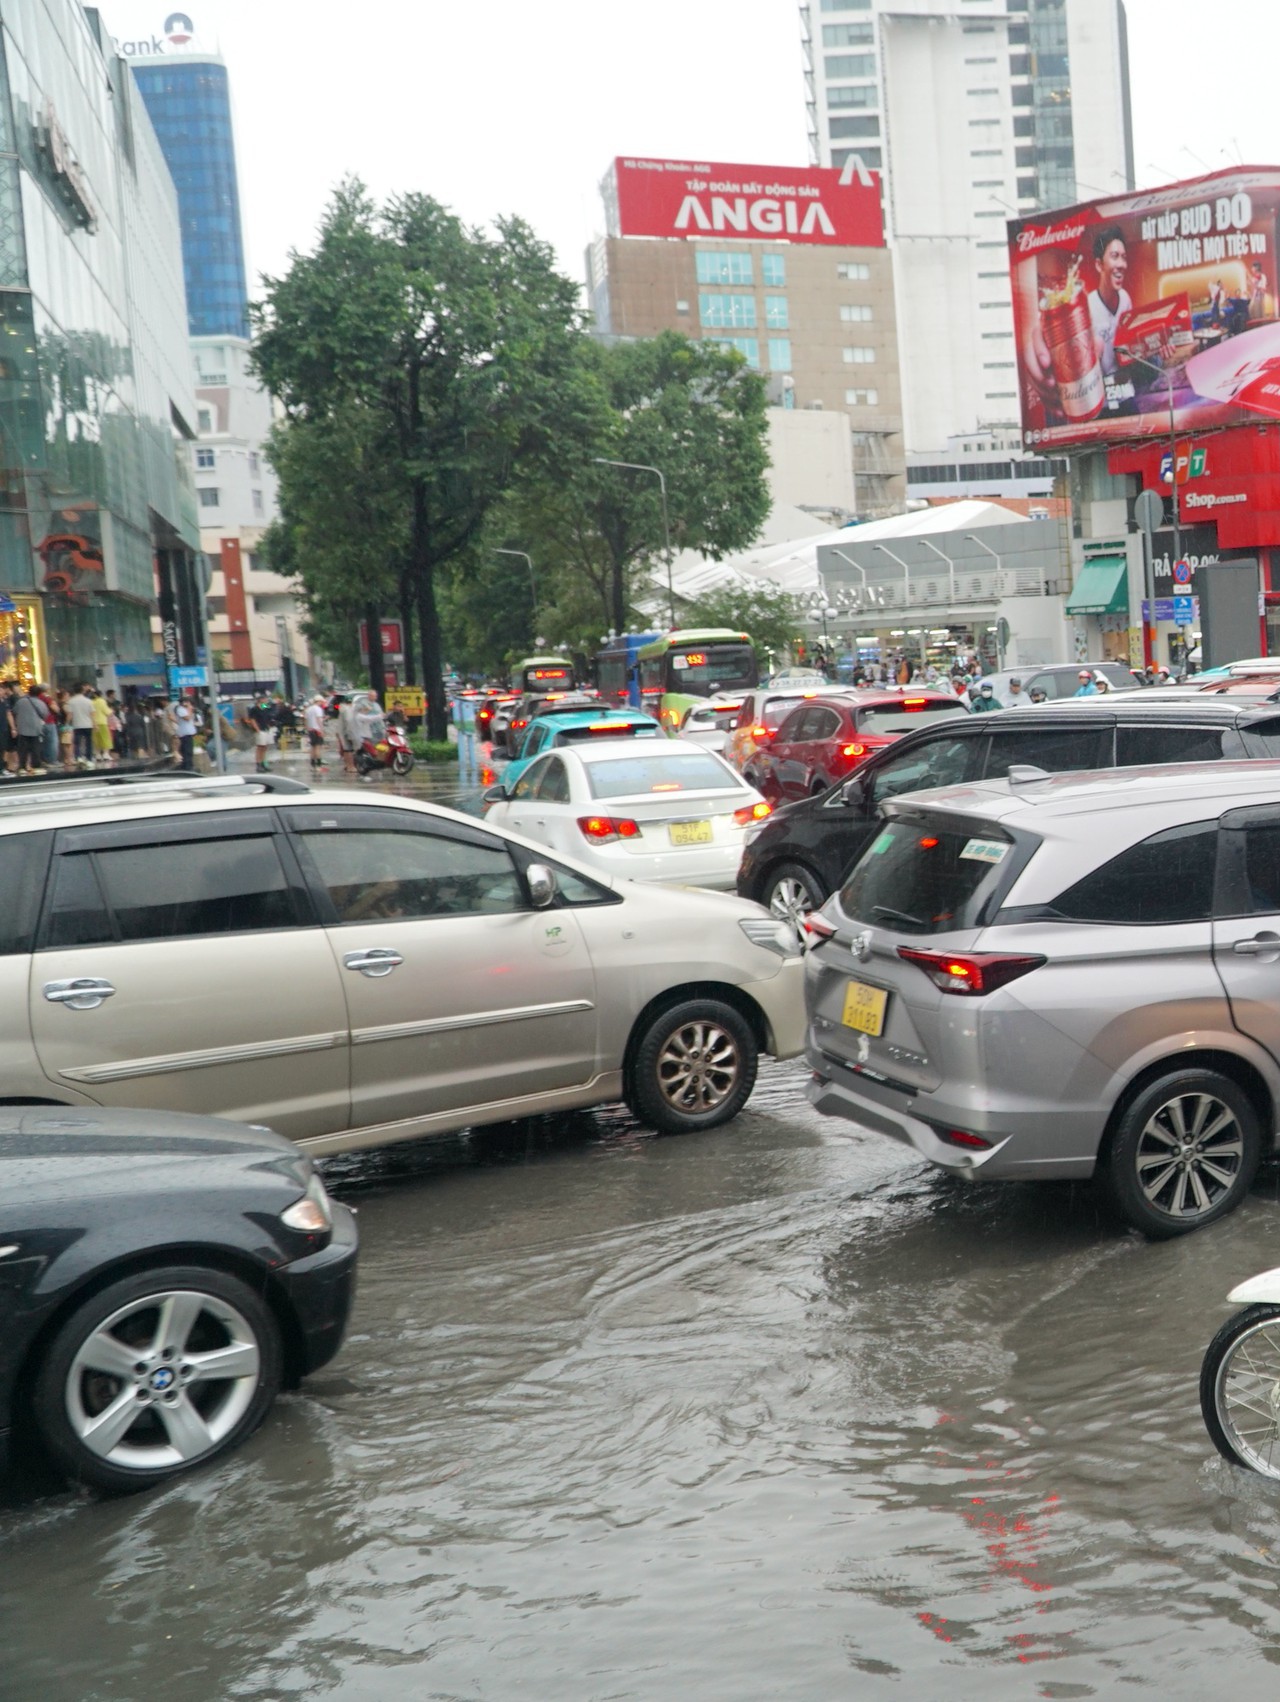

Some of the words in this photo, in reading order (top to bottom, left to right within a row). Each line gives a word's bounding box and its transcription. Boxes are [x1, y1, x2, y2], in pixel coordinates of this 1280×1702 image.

[686, 179, 707, 193] TẬP
[709, 181, 740, 194] ĐOÀN
[765, 182, 796, 197] ĐỘNG
[674, 195, 836, 236] ANGIA
[1181, 203, 1212, 235] BUD
[1017, 224, 1085, 253] Budweiser
[1157, 235, 1201, 271] MỪNG
[1203, 237, 1225, 263] MỌI
[1226, 230, 1248, 259] TIỆC
[1249, 233, 1266, 254] VUI
[1185, 493, 1248, 509] Shop.com.vn
[164, 621, 178, 666] SAIGON
